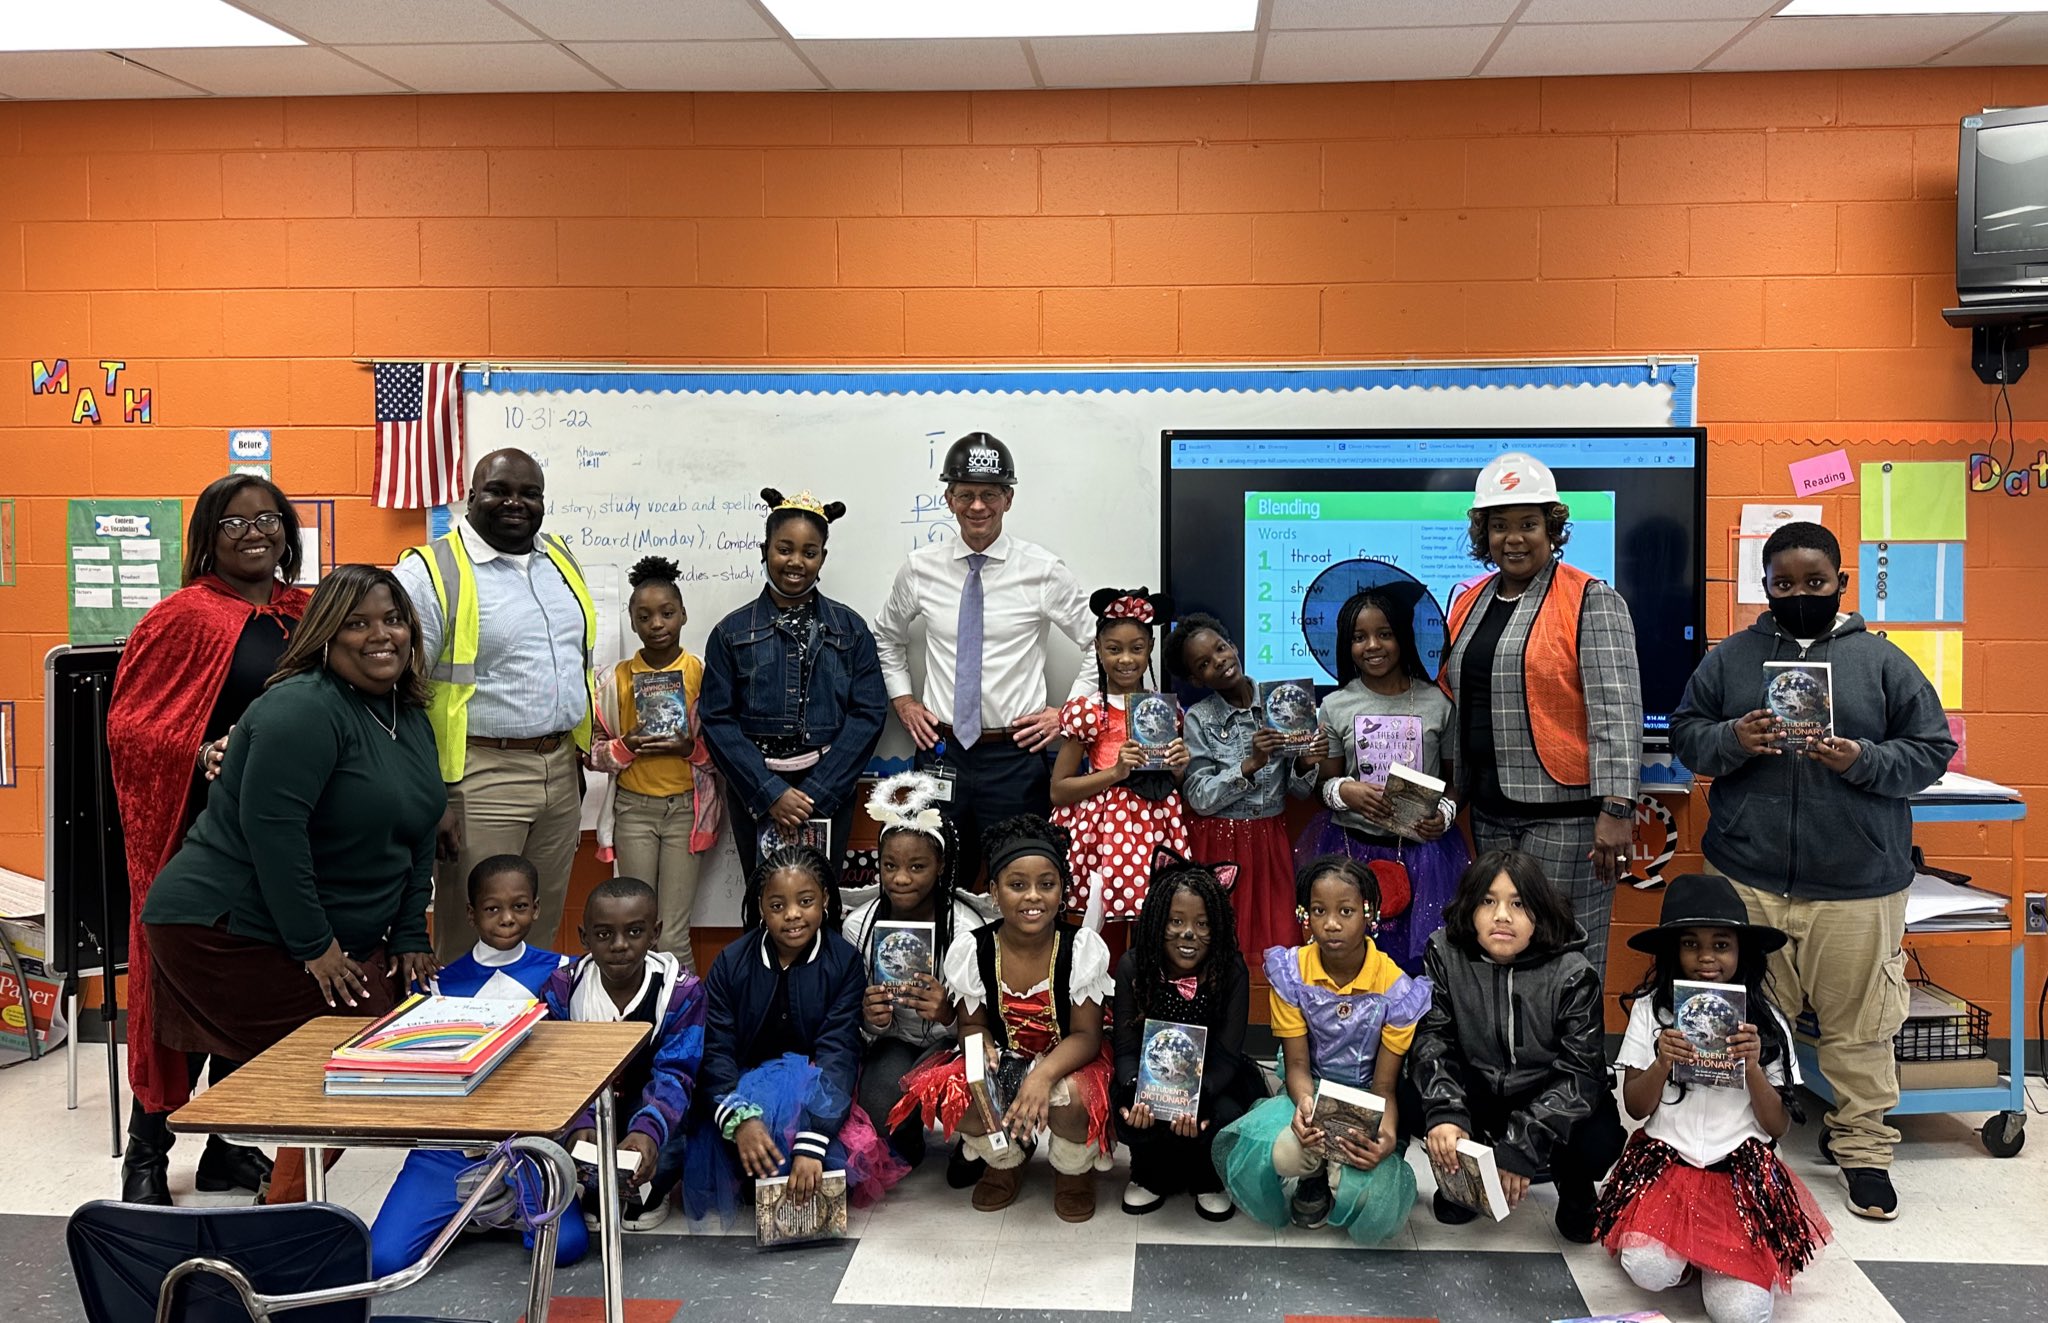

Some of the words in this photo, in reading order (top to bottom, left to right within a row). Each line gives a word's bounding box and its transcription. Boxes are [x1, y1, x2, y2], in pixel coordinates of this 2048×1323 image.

[31, 359, 151, 424] MATH
[968, 457, 1000, 468] SCOTT
[969, 449, 999, 459] WARD
[1803, 471, 1846, 490] Reading
[600, 493, 641, 520] study
[648, 495, 688, 513] vocab
[692, 496, 716, 512] and
[722, 494, 769, 518] spelling
[1258, 498, 1321, 519] Blending
[110, 525, 139, 533] Vocabulary
[1258, 528, 1297, 540] Words
[1258, 550, 1271, 570] 1
[1291, 549, 1332, 563] throat
[1357, 549, 1399, 566] foamy
[1258, 581, 1273, 601] 2
[1290, 580, 1324, 594] show
[1258, 613, 1272, 633] 3
[1291, 611, 1325, 626] toast
[1258, 644, 1273, 664] 4
[1377, 731, 1400, 740] THESE
[1385, 742, 1391, 750] A
[1140, 1091, 1191, 1107] DICTIONARY
[1151, 1085, 1189, 1097] STUDENT'S
